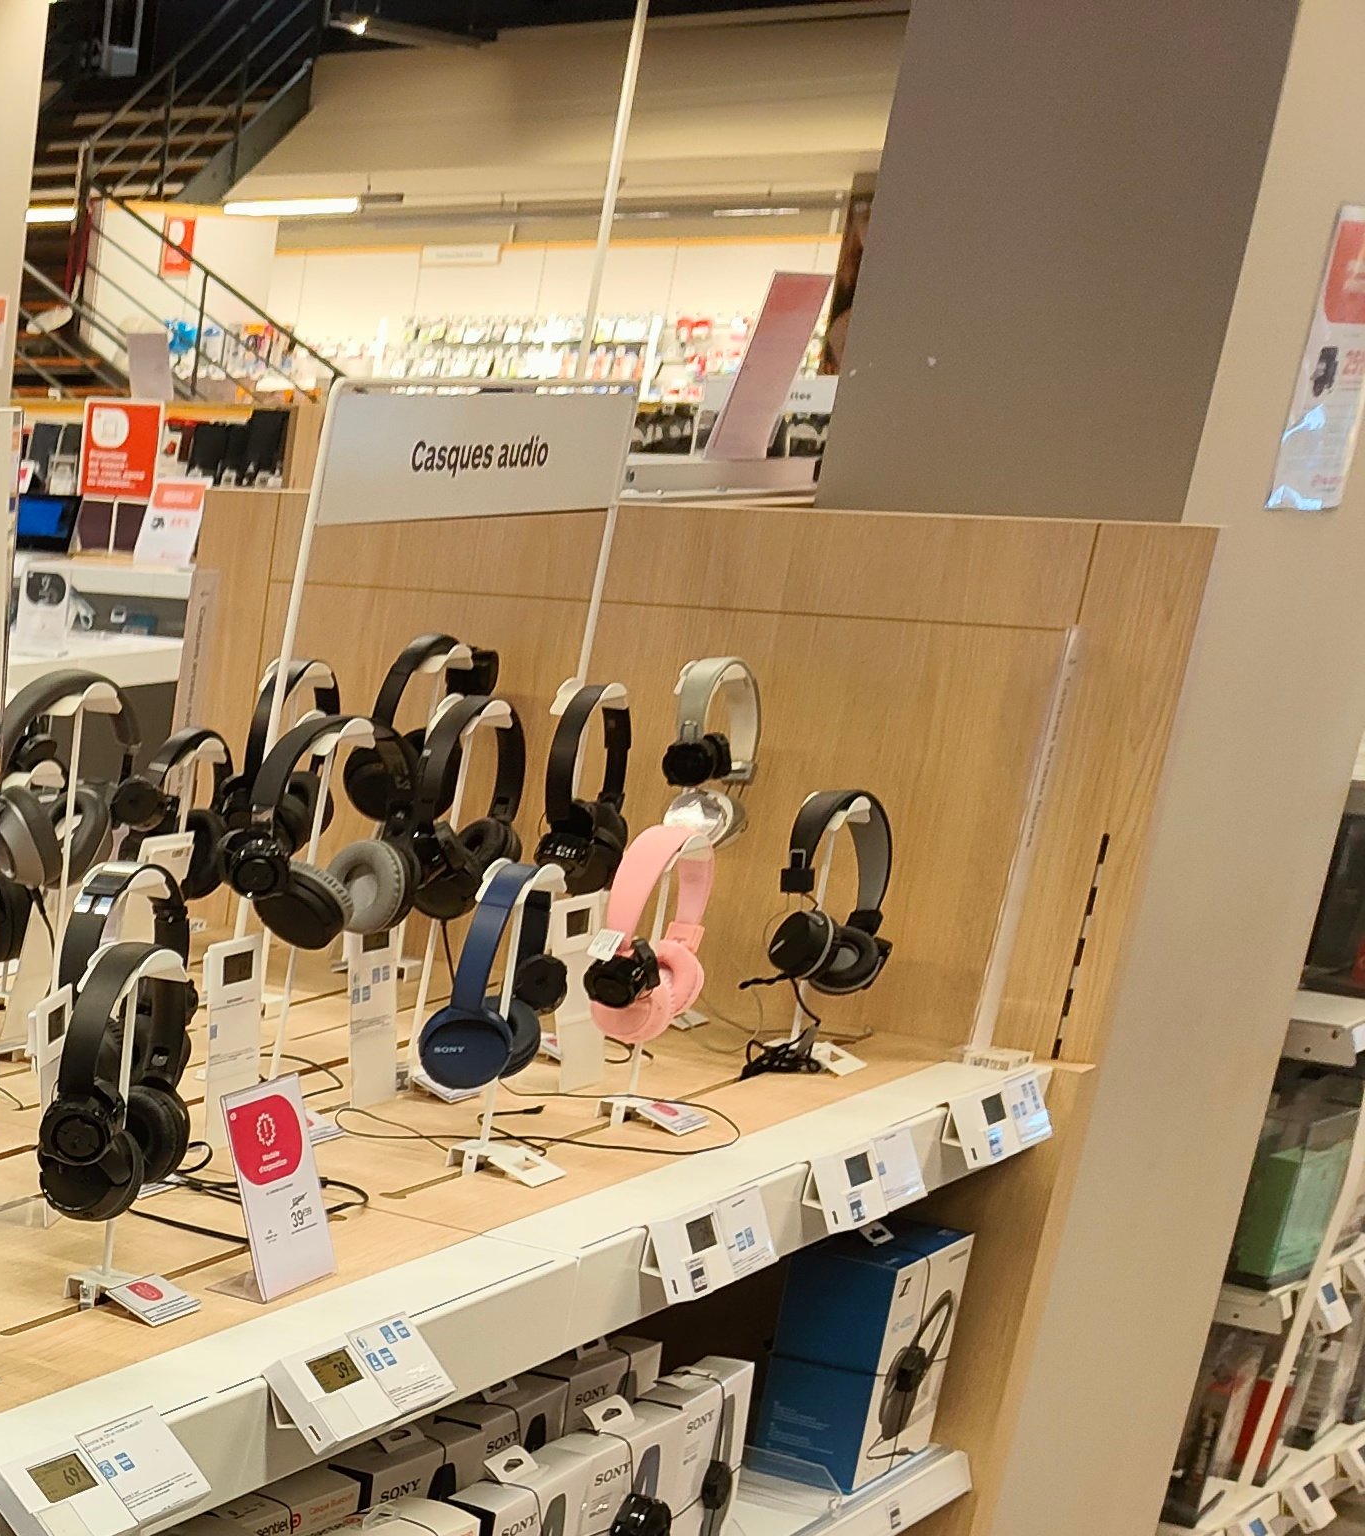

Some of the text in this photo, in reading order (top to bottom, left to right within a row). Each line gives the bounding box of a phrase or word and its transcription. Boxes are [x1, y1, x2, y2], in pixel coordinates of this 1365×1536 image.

[412, 434, 549, 478] Casques audio
[333, 1361, 348, 1378] 39
[575, 1384, 609, 1406] SONY
[687, 1410, 715, 1434] SONY
[66, 1468, 81, 1487] 69
